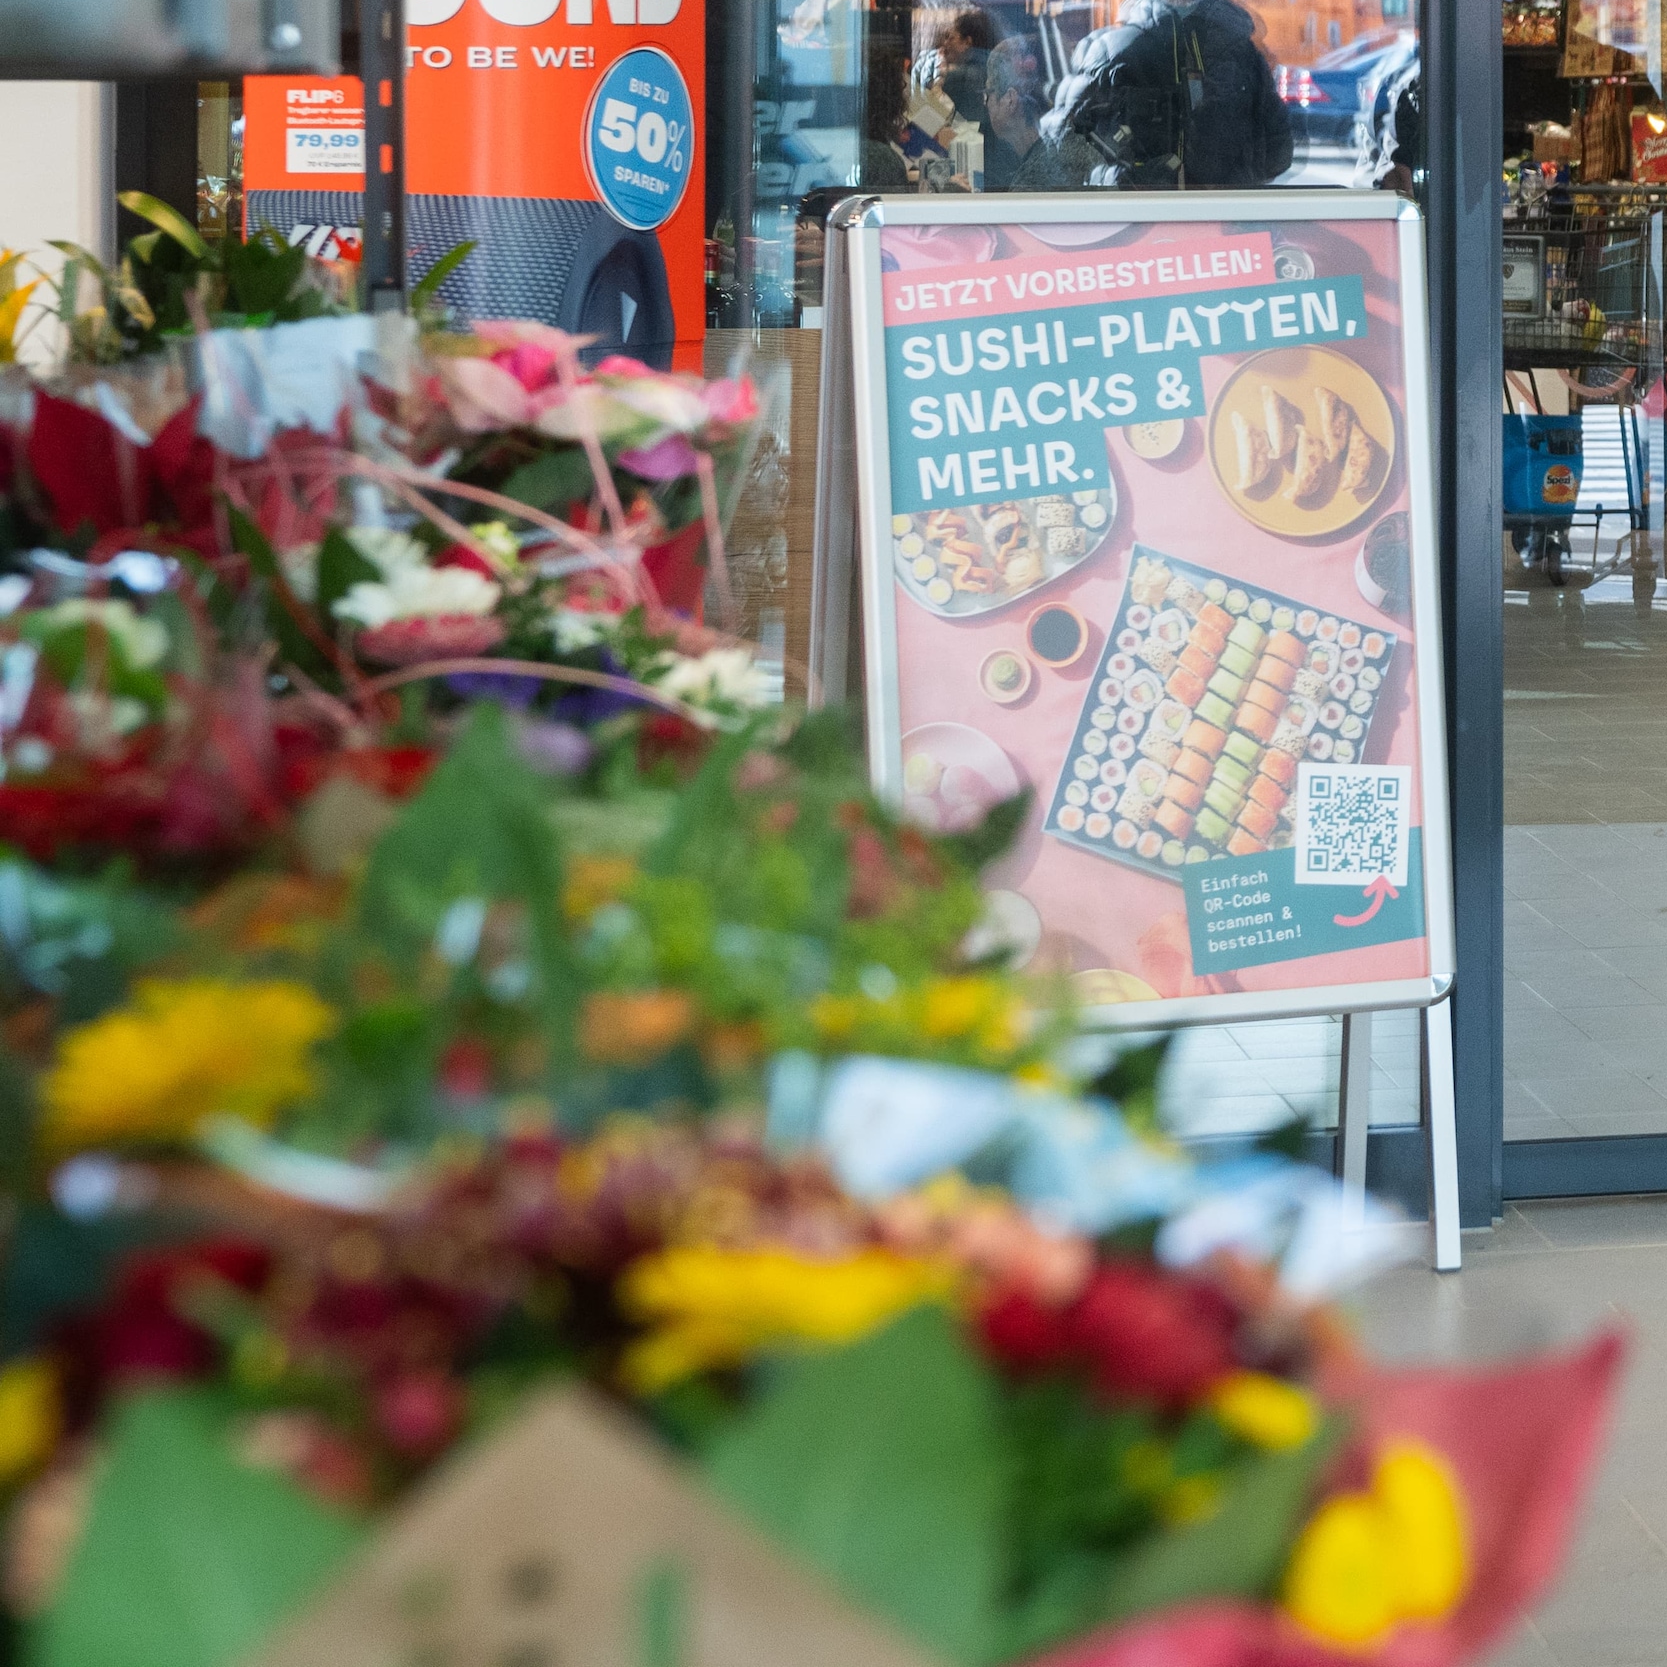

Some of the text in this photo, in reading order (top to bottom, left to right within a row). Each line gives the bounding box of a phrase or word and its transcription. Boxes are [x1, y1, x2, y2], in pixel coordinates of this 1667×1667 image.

[467, 46, 520, 70] BE
[531, 46, 596, 70] WE!
[629, 77, 670, 105] BIS ZU
[294, 133, 361, 151] 79,99
[598, 97, 687, 173] 50%
[895, 248, 1264, 313] JETZT VORBESTELLEN:
[901, 289, 1359, 381] SUSHI-PLATTEN,
[908, 366, 1193, 439] SNACKS &
[917, 439, 1096, 501] MEHR.
[1546, 475, 1571, 486] Spezi
[1200, 870, 1269, 894] Einfach
[1203, 889, 1272, 915] QR-Code
[1206, 906, 1294, 934] scannen &
[1207, 925, 1303, 954] bestellen!
